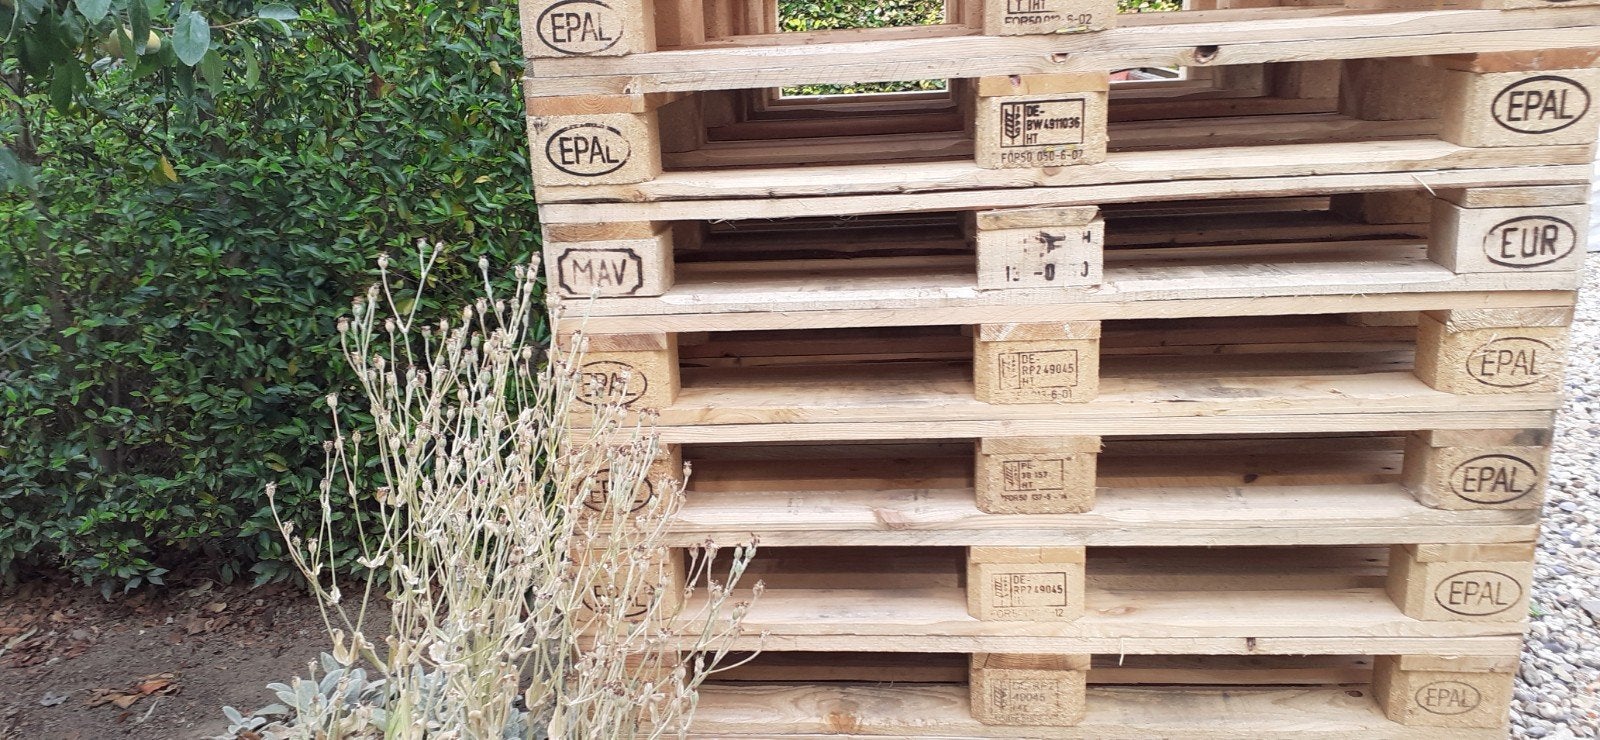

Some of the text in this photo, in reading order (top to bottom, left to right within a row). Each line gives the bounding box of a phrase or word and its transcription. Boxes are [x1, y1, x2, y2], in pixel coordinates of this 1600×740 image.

[551, 12, 612, 42] EPAL
[1026, 105, 1045, 117] DE-
[1507, 89, 1574, 121] EPAL
[559, 136, 619, 164] EPAL
[1026, 133, 1038, 144] HT
[1501, 225, 1558, 258] EUR
[573, 259, 626, 286] MAV
[1022, 354, 1040, 364] DE-
[1481, 349, 1538, 376] EPAL
[1463, 467, 1523, 492] EPAL
[1013, 575, 1031, 584] DE-
[1449, 581, 1508, 605] EPAL
[1426, 688, 1471, 707] EPAL
